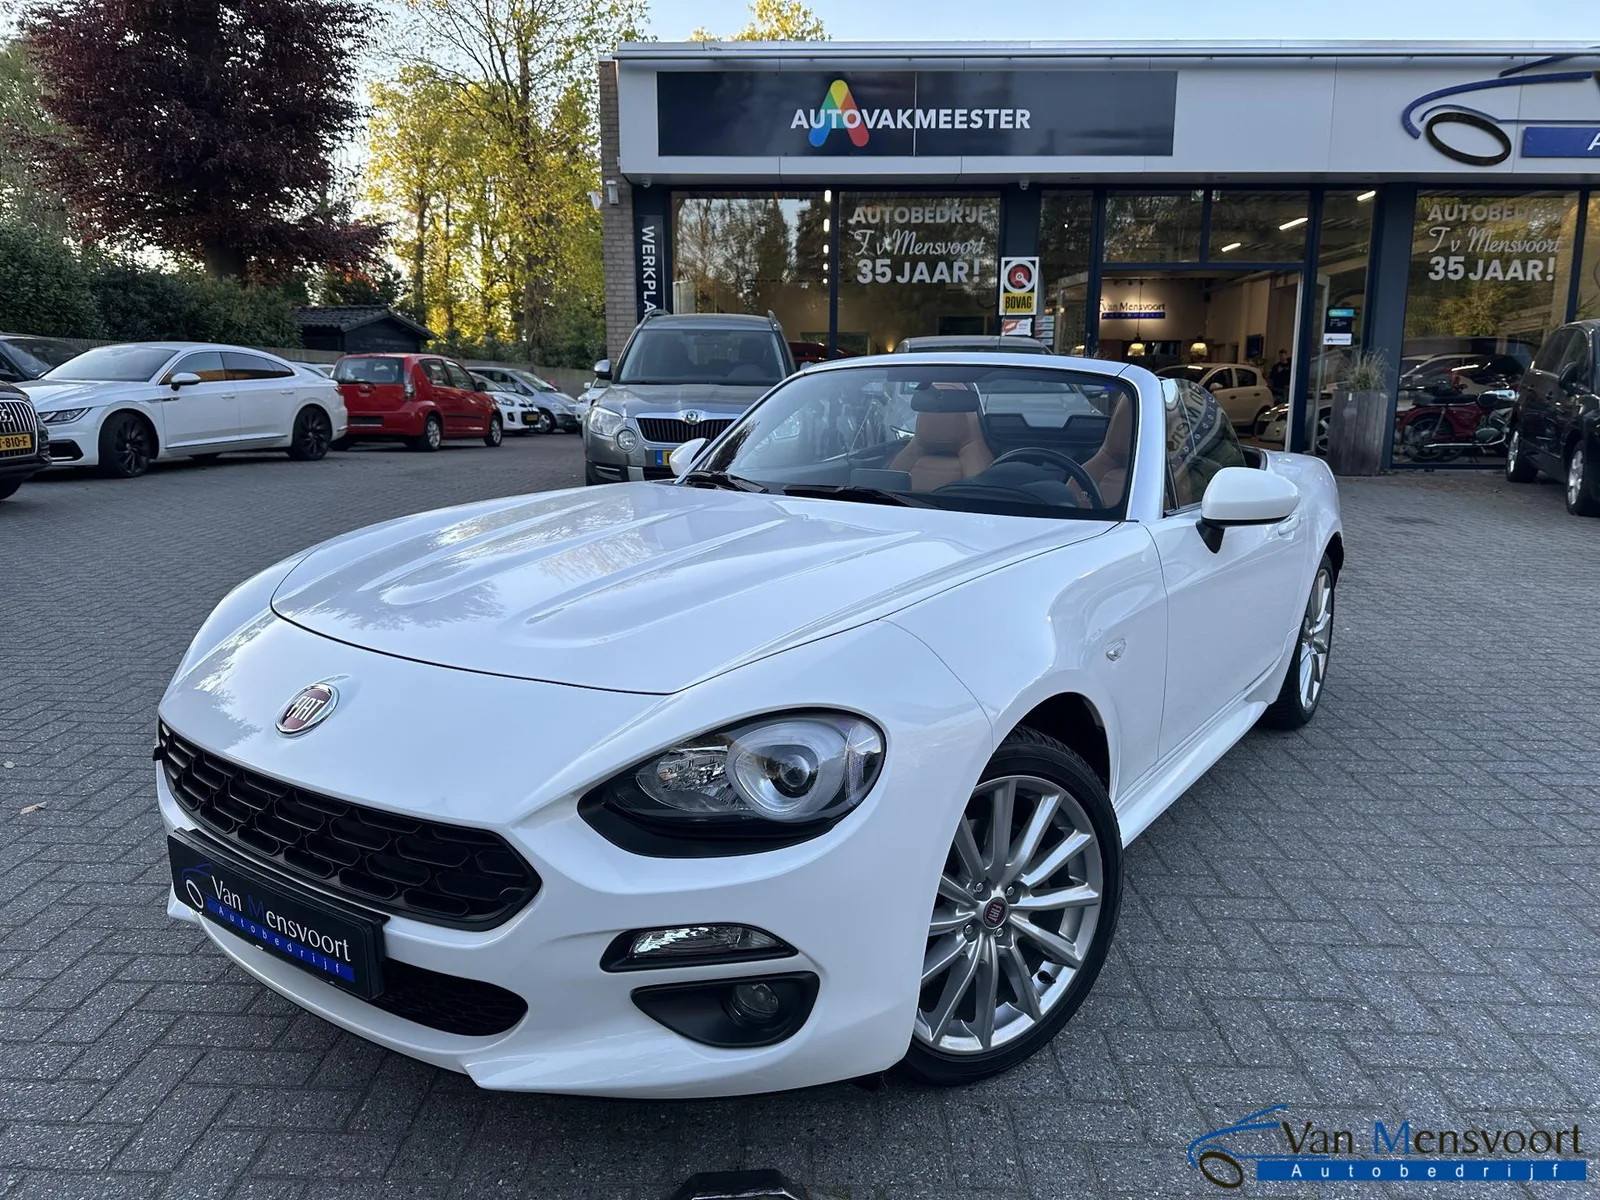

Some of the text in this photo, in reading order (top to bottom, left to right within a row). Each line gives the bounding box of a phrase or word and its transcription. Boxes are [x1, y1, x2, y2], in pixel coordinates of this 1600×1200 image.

[790, 108, 1031, 130] AUTOVAKMEESTER
[892, 228, 986, 255] Mensvoort
[1467, 226, 1563, 253] Mensvoort
[856, 258, 981, 284] 35 JAAR!
[1428, 256, 1556, 282] 35 JAAR!
[1005, 296, 1032, 309] BOVAG
[286, 695, 325, 722] FIAT
[211, 875, 352, 962] Van Mensvoort
[218, 907, 341, 974] Autobedrijf
